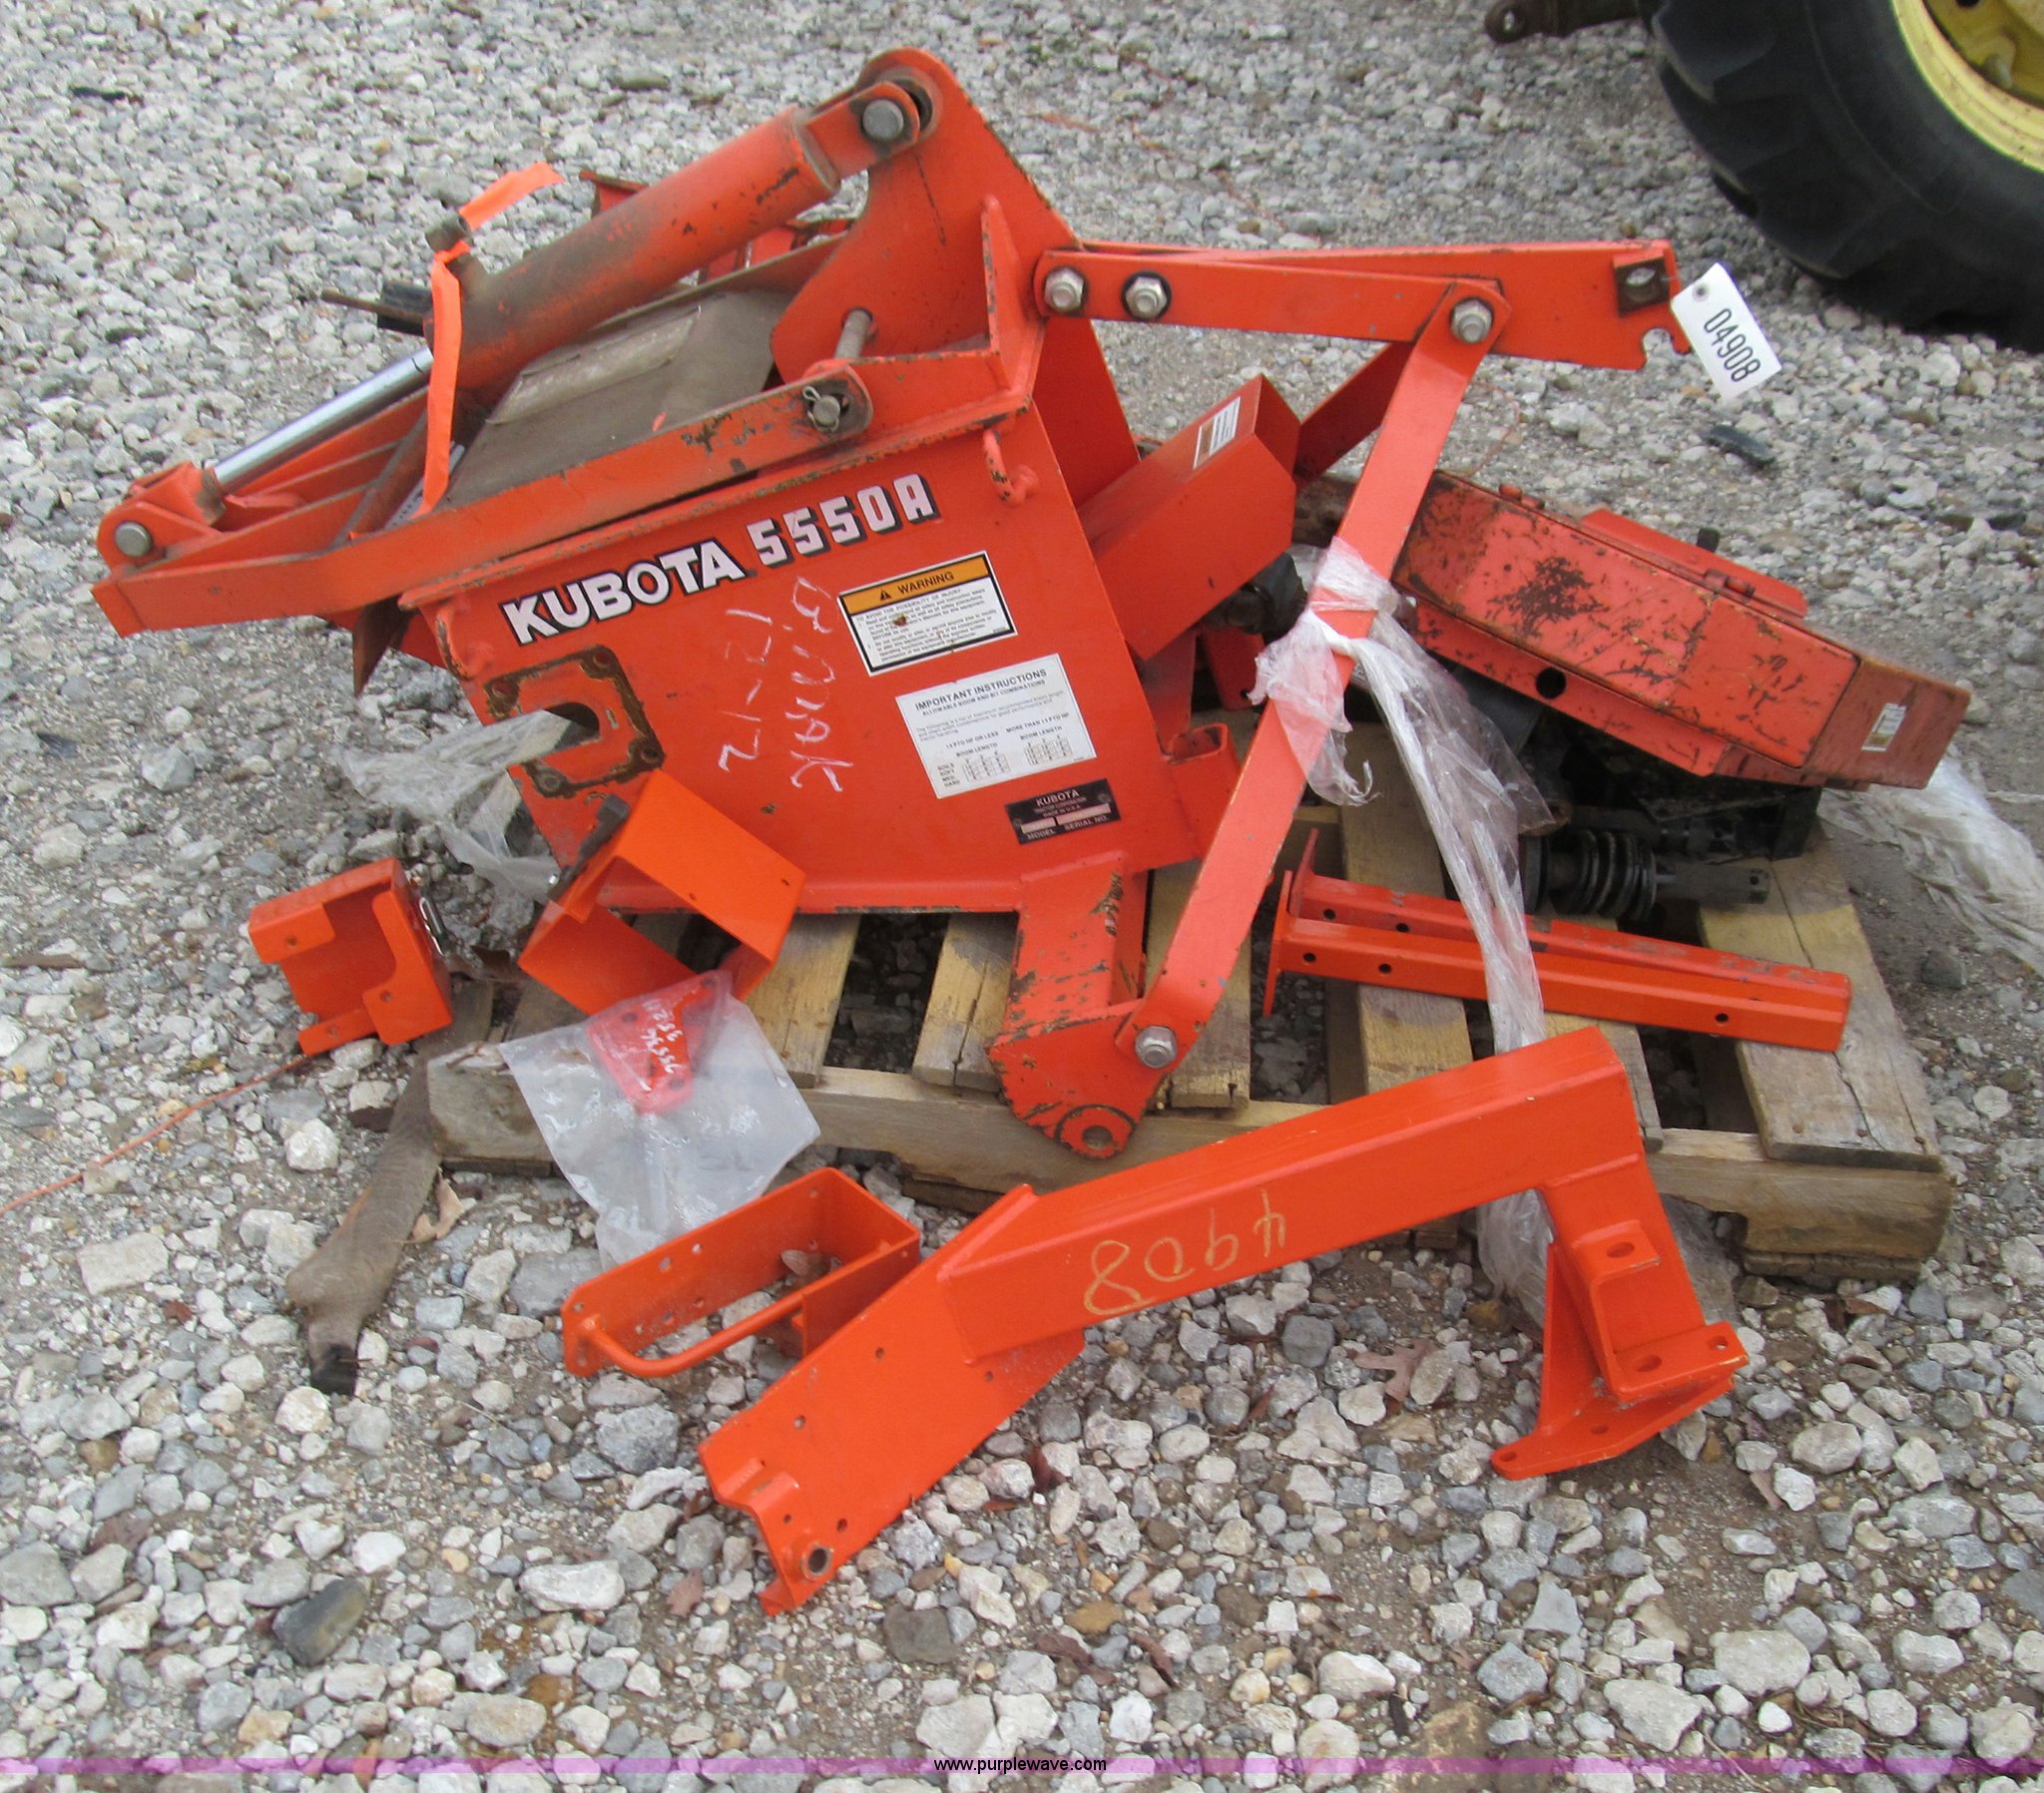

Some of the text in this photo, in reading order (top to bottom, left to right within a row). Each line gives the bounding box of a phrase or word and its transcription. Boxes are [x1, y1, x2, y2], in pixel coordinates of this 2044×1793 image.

[1703, 307, 1762, 383] 04908
[502, 537, 750, 647] KUBOTA
[746, 473, 939, 568] 5550A
[897, 572, 954, 595] WARNING
[914, 669, 1047, 710] IMPORTANT INSTRUCTIONS
[922, 702, 957, 716] ALLOWABLE
[1000, 679, 1045, 695] COMBINATIONS
[1036, 788, 1079, 807] KUBOTA
[1027, 827, 1056, 840] MODEL
[1064, 818, 1093, 831] SERIAL
[1084, 1188, 1287, 1316] 4908
